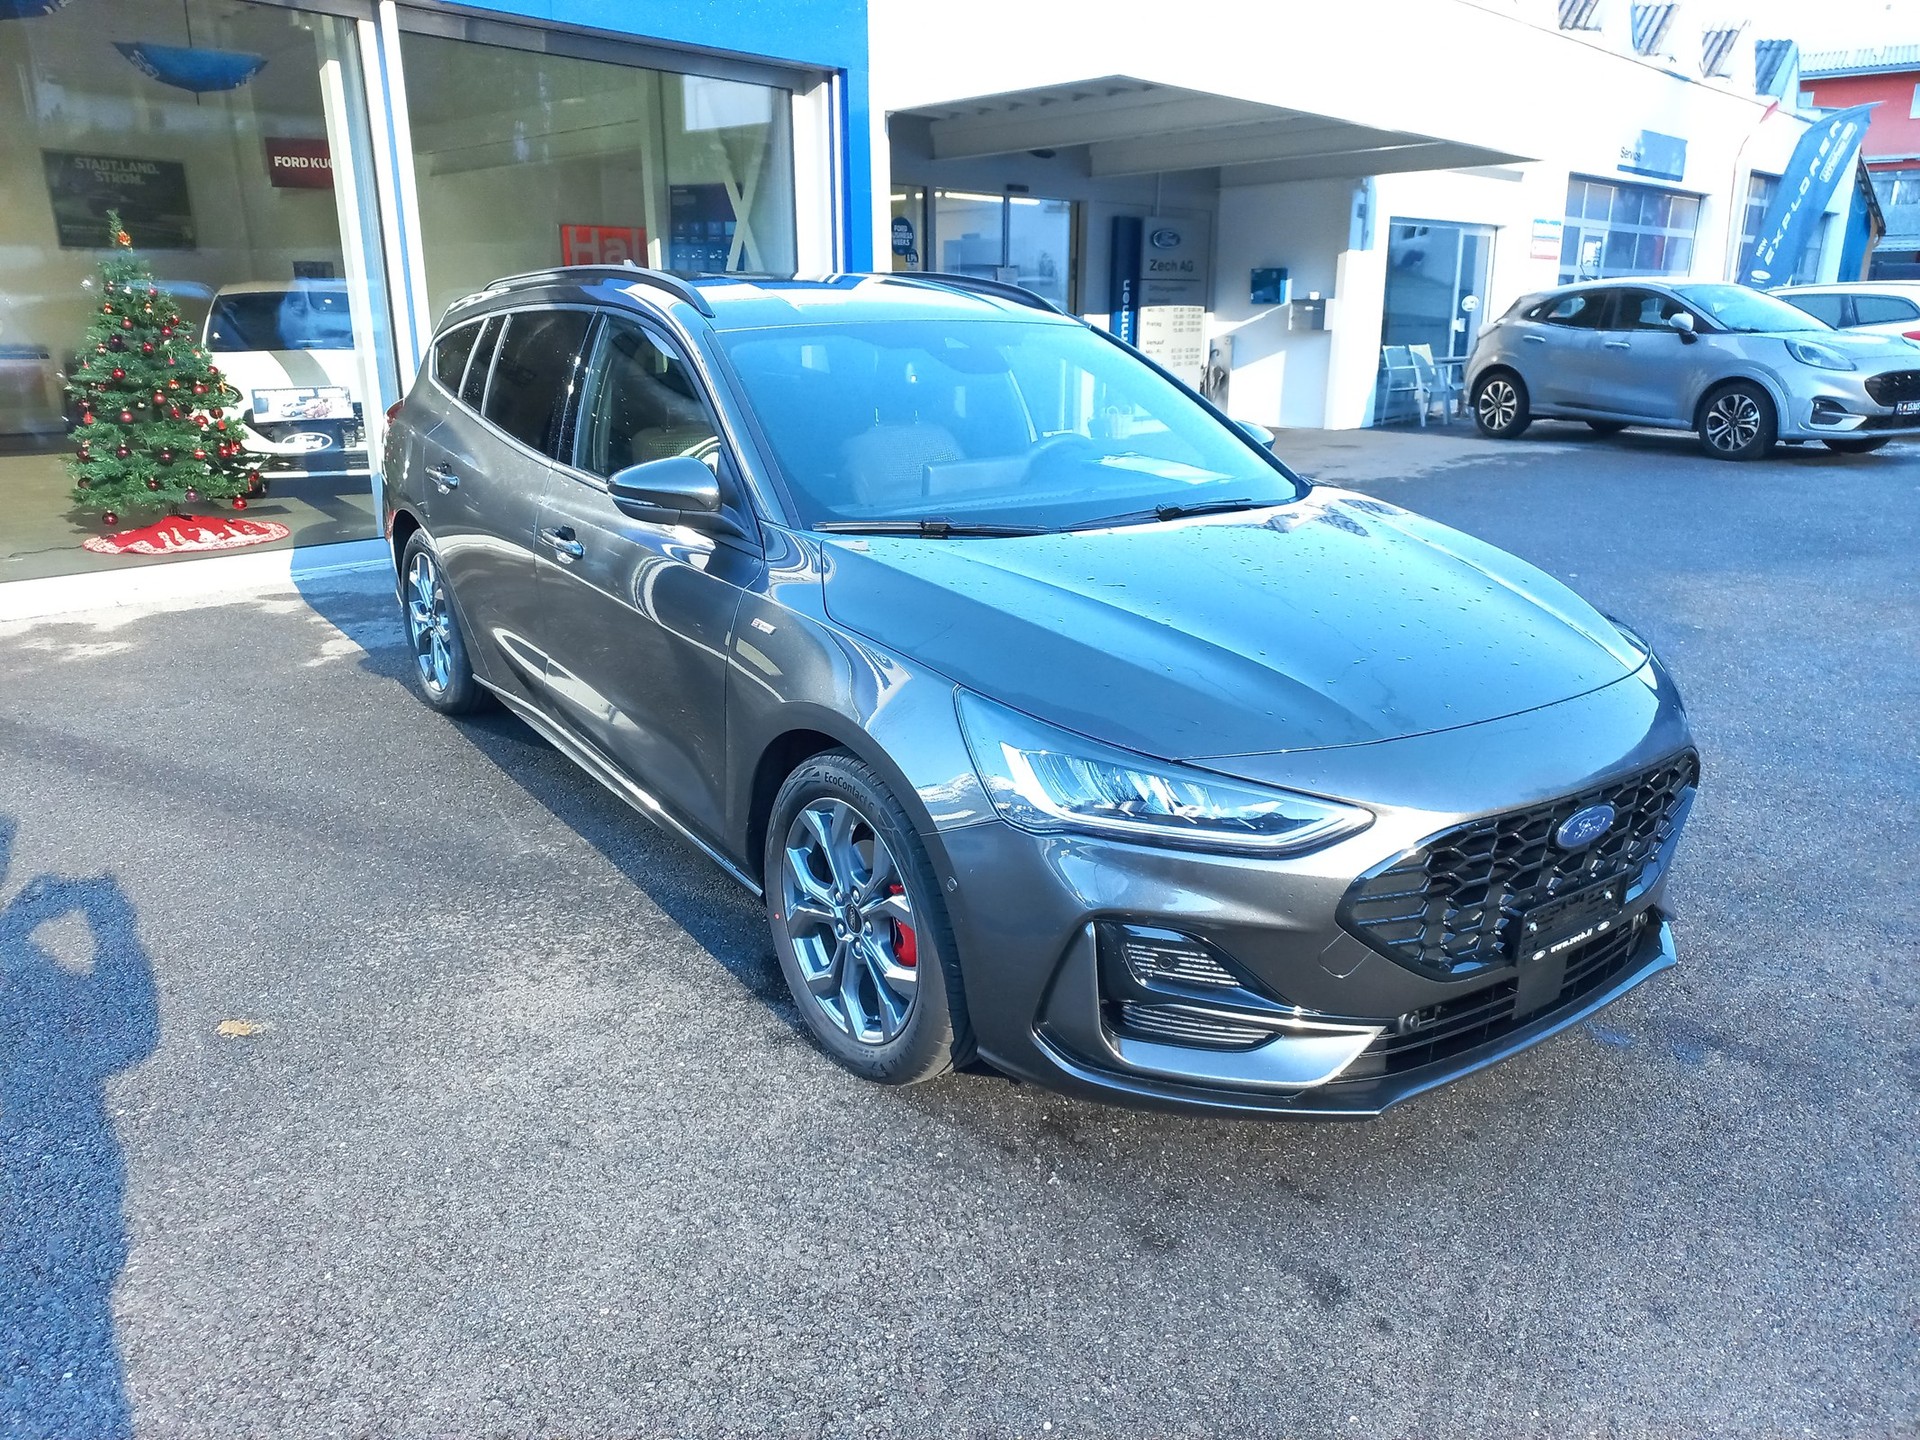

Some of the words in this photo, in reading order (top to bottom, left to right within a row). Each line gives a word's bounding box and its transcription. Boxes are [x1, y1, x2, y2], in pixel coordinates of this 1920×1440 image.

[273, 155, 309, 168] FORD
[1755, 237, 1768, 257] NEW
[1149, 259, 1177, 271] Zech
[1180, 260, 1194, 272] AG
[824, 772, 868, 805] EcoContact
[868, 802, 875, 812] 6
